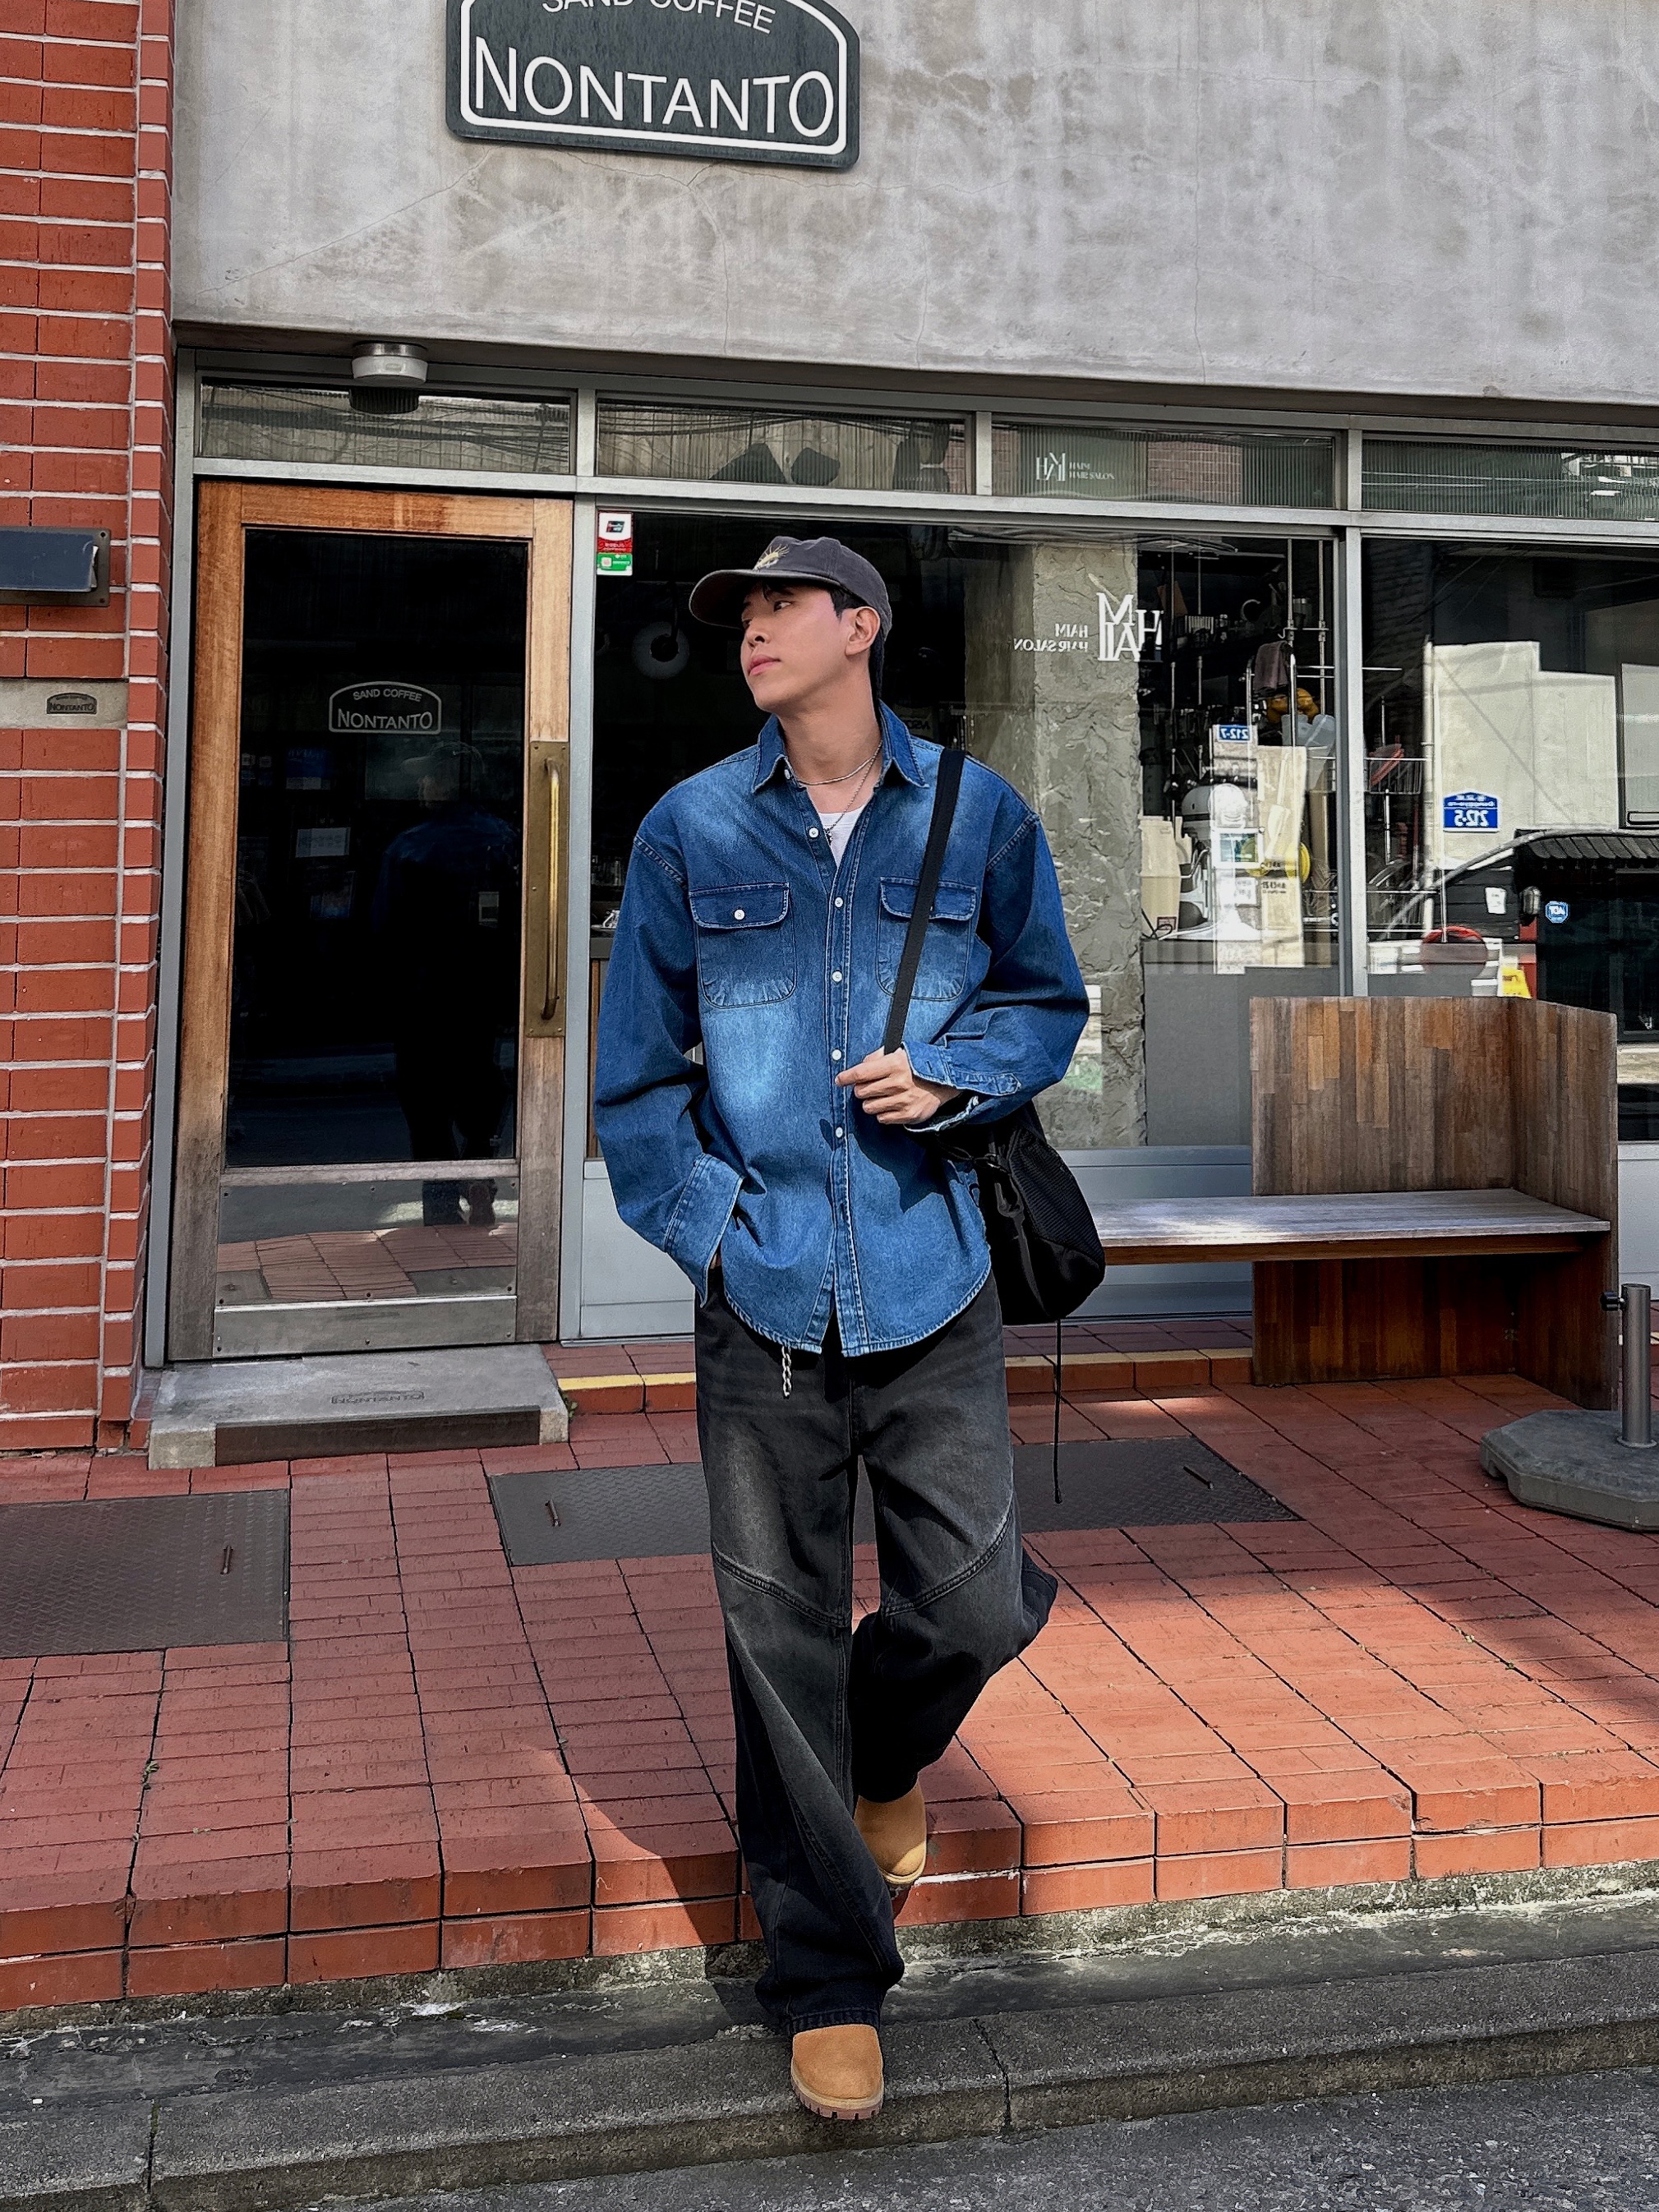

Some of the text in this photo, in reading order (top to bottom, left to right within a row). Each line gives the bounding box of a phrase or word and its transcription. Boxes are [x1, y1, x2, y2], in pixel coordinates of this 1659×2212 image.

[474, 35, 834, 138] NONTANTO
[353, 689, 422, 702] SAND COFFEE
[338, 708, 432, 729] NONTANTO
